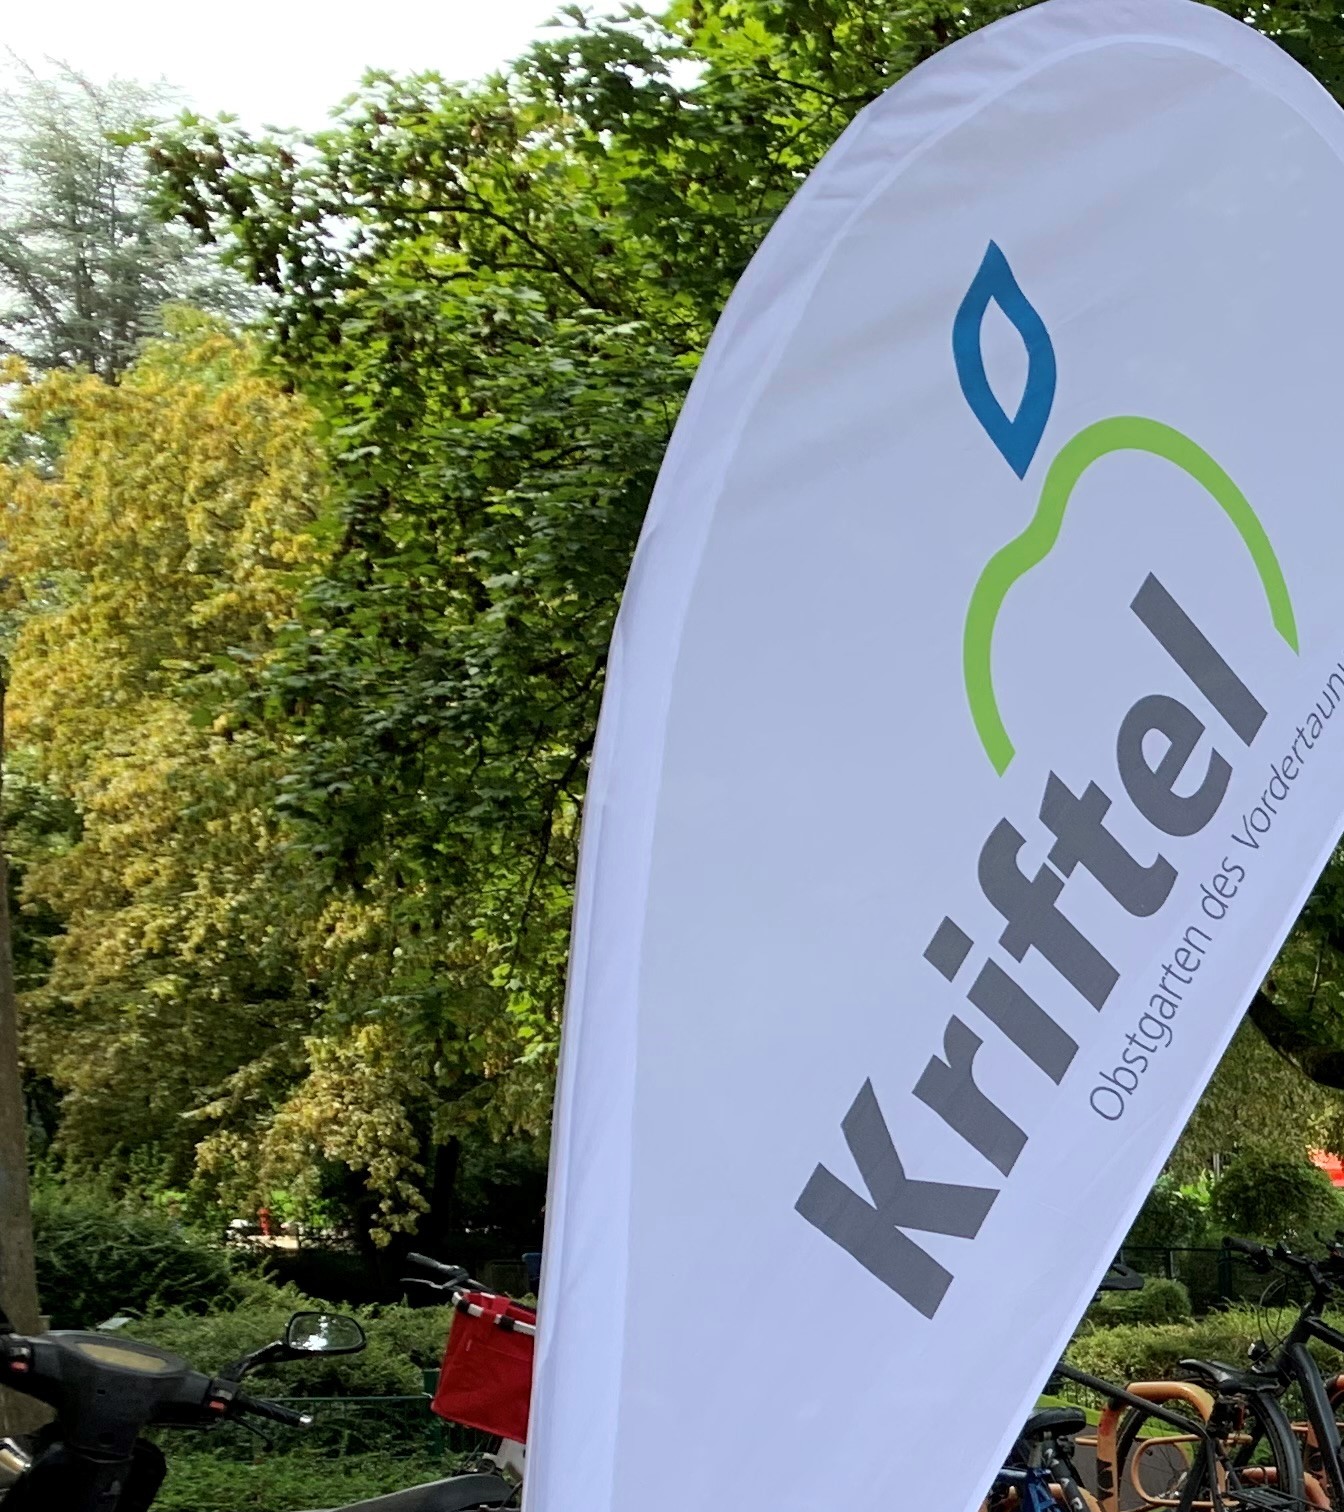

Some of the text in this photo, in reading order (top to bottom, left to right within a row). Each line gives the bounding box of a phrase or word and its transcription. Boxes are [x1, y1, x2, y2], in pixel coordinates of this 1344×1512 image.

[794, 571, 1269, 1321] Kriftel
[1088, 922, 1213, 1122] Obstgarten
[1199, 855, 1247, 921] des
